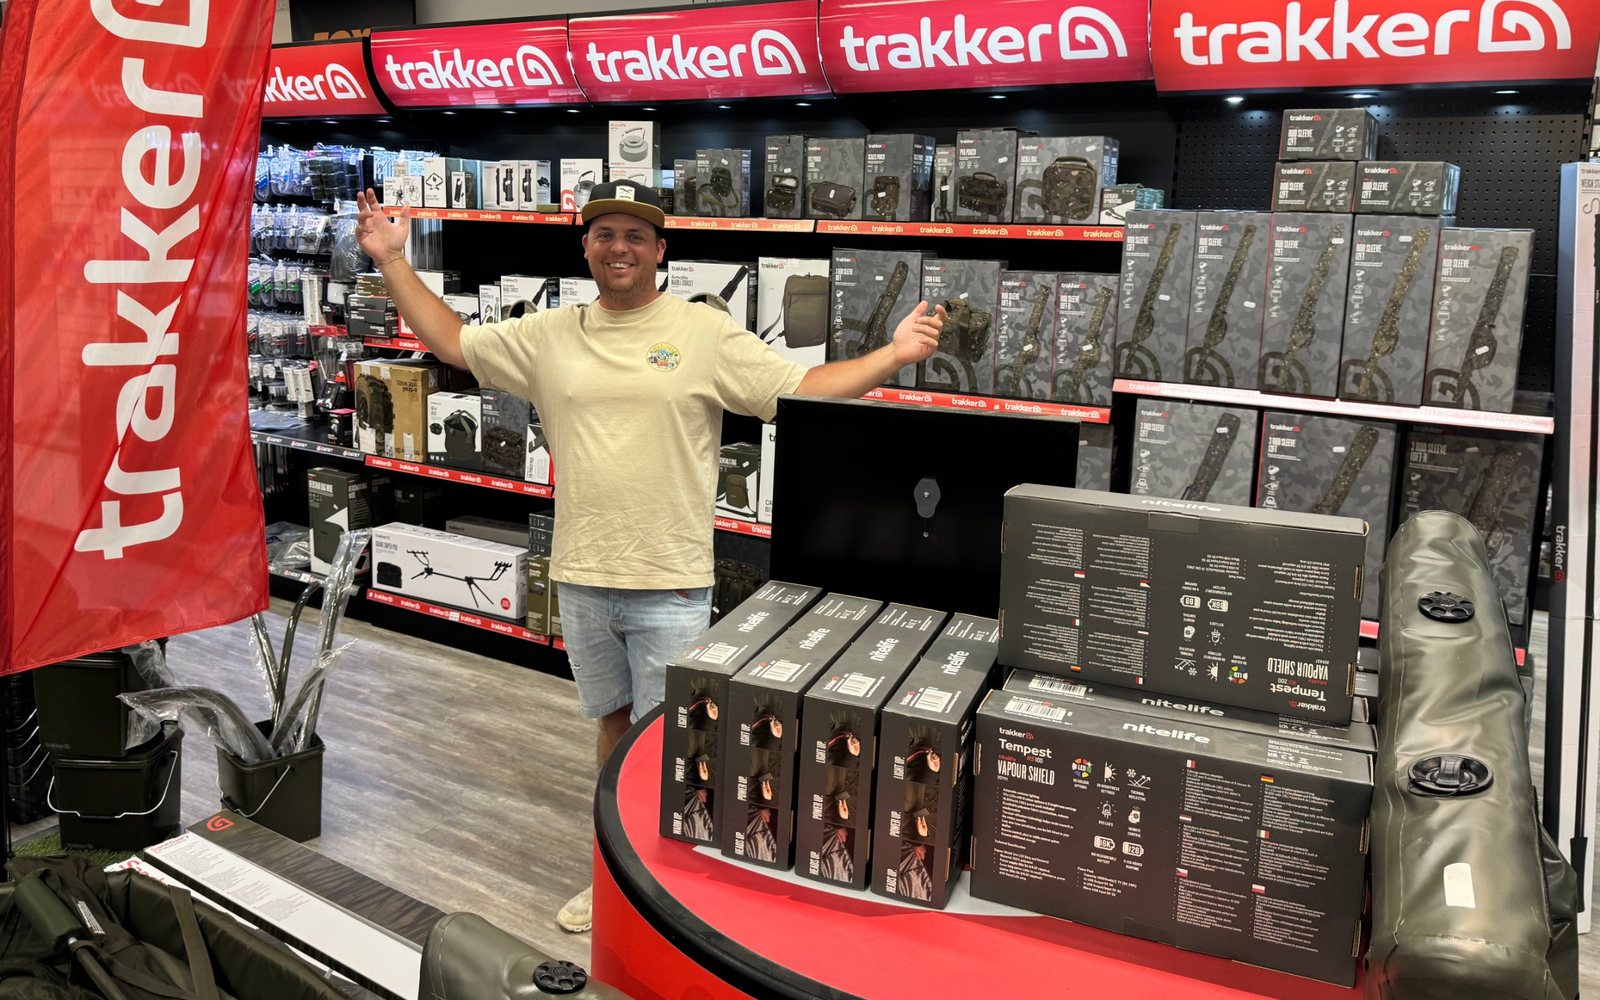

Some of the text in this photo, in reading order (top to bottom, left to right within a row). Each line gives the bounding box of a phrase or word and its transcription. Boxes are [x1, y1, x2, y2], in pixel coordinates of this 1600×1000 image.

[1174, 0, 1470, 66] trakker
[840, 14, 1052, 72] trakker
[586, 34, 747, 83] trakker
[385, 48, 514, 90] trakker
[264, 66, 328, 102] kker
[1298, 129, 1313, 138] SLEEVE
[1364, 167, 1389, 175] trakker
[1289, 182, 1304, 191] SLEEVE
[1372, 182, 1389, 191] SLEEVE
[731, 221, 751, 229] trakker
[772, 222, 794, 230] trakker
[827, 224, 850, 232] trakker
[871, 225, 895, 233] trakker
[920, 226, 945, 234] trakker
[973, 227, 1000, 235] trakker
[1027, 228, 1056, 237] trakker
[1083, 229, 1115, 238] trakker
[1357, 229, 1384, 237] trakker
[1135, 236, 1149, 244] SLEEVE
[1208, 238, 1223, 247] SLEEVE
[1284, 240, 1299, 249] SLEEVE
[1366, 244, 1383, 253] SLEEVE
[1452, 259, 1470, 268] SLEEVE
[74, 57, 204, 561] trakker
[899, 392, 925, 402] trakker
[952, 397, 979, 408] trakker
[1005, 402, 1034, 412] trakker
[1061, 407, 1092, 418] trakker
[1270, 423, 1294, 432] trakker
[1281, 438, 1297, 447] SLEEVE
[1427, 443, 1447, 455] SLEEVE
[399, 463, 415, 471] trakker
[428, 468, 445, 476] trakker
[460, 474, 477, 482] trakker
[491, 479, 509, 488] trakker
[523, 485, 541, 494] trakker
[1141, 499, 1223, 512] nitelife
[714, 520, 732, 528] rakker
[751, 526, 771, 535] trakke
[1554, 524, 1567, 570] trakker
[374, 592, 390, 602] trakker
[401, 600, 417, 609] trakker
[429, 607, 446, 616] trakker
[460, 615, 477, 624] trakker
[737, 611, 770, 633] nitelife
[491, 622, 508, 632] trakker
[799, 628, 831, 650] nitelife
[868, 637, 900, 662] nitelife
[941, 650, 970, 676] nitelife
[1267, 657, 1329, 681] SHIELD VAPOUR
[1270, 682, 1327, 702] Tempest
[1141, 697, 1225, 718] nitelife
[1297, 701, 1326, 713] trakker
[678, 706, 688, 729] LIGHT UP.
[740, 723, 750, 746] LIGHT UP.
[999, 726, 1026, 738] trakker
[1122, 722, 1211, 745] nitelife
[816, 740, 827, 764] LIGHT UP.
[998, 738, 1053, 759] Tempest
[675, 757, 685, 782] POWER UP.
[893, 755, 905, 780] LIGHT UP.
[997, 759, 1055, 786] VAPOUR SHIELD
[737, 775, 748, 801] POWER UP.
[812, 793, 824, 821] POWER UP.
[673, 811, 683, 835] WARM UP.
[889, 810, 902, 838] POWER UP.
[734, 831, 745, 856] HEADS UP.
[809, 851, 820, 876] HEADS UP.
[886, 868, 898, 894] HEADS UP.
